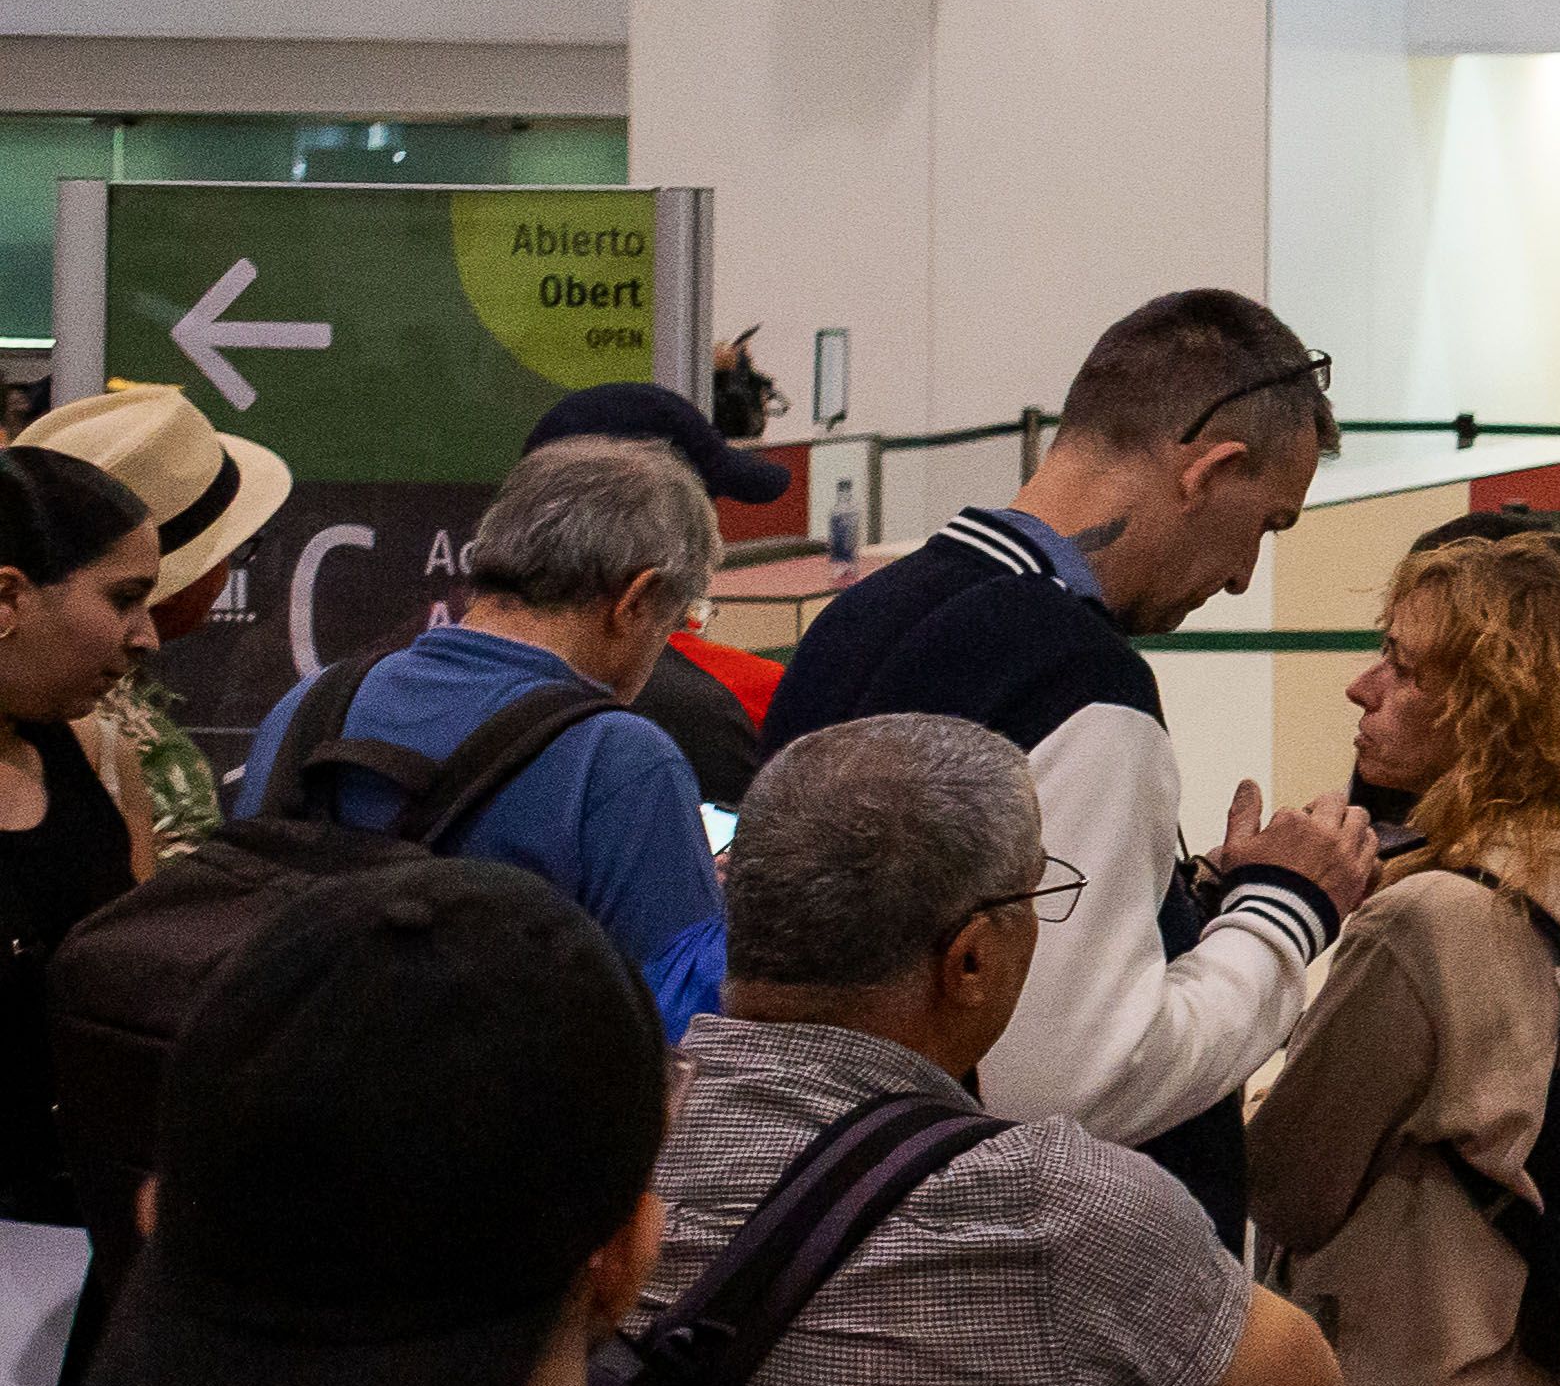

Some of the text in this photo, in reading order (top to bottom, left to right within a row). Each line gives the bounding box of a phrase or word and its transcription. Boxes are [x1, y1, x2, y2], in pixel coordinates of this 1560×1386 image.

[511, 224, 645, 258] Abierto
[538, 275, 645, 310] Obert
[584, 327, 644, 349] OPEN
